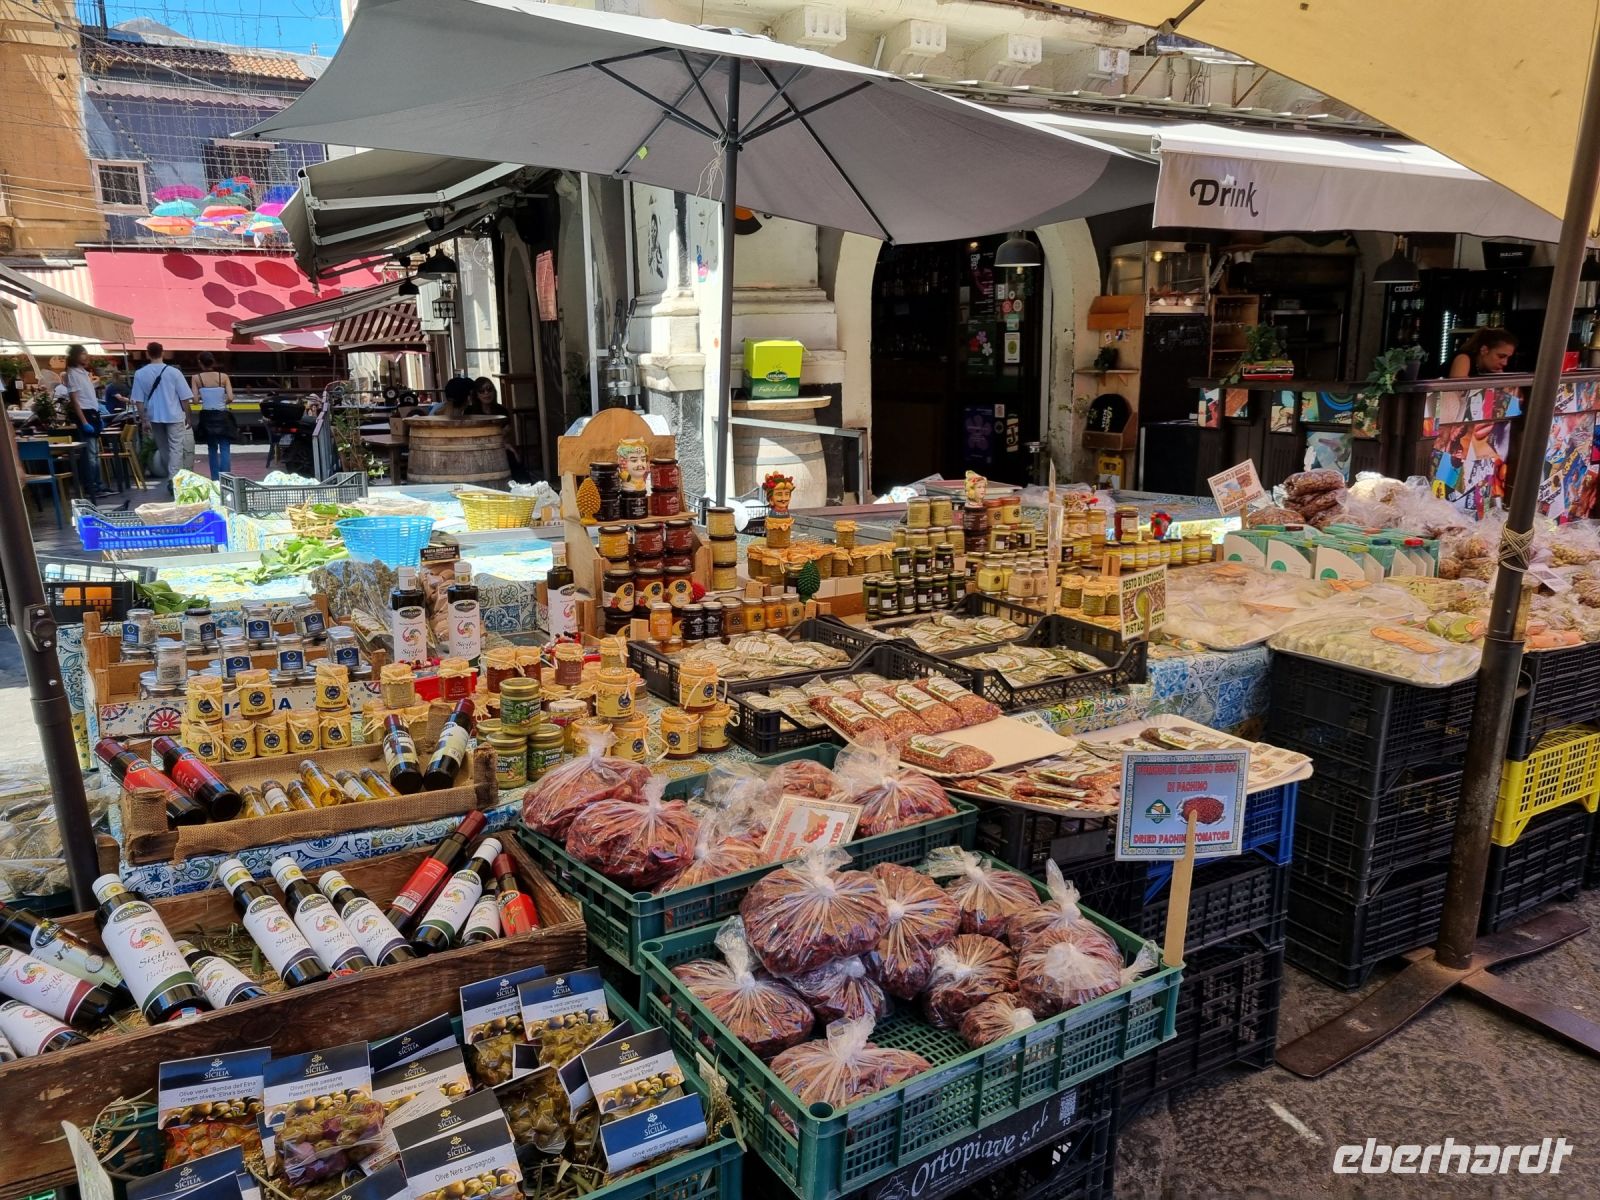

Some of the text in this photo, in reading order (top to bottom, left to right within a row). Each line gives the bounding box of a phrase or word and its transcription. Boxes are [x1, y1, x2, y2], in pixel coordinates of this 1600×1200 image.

[1190, 179, 1259, 217] Drink
[1133, 834, 1157, 844] DRIED
[1158, 833, 1188, 843] PACHIN
[496, 988, 516, 998] SICILIA
[552, 987, 571, 995] SICILIA
[618, 1052, 639, 1061] SICILIA
[204, 1070, 230, 1079] SICILIA
[305, 1065, 329, 1075] SICILIA
[404, 1067, 427, 1077] SICILIA
[438, 1116, 462, 1130] SICILIA
[643, 1125, 668, 1136] SICILIA
[446, 1146, 472, 1159] SICILIA
[434, 1155, 496, 1182] Olive Nere campagnole
[911, 1133, 1016, 1197] Ortopiave
[174, 1177, 201, 1190] SICILIA
